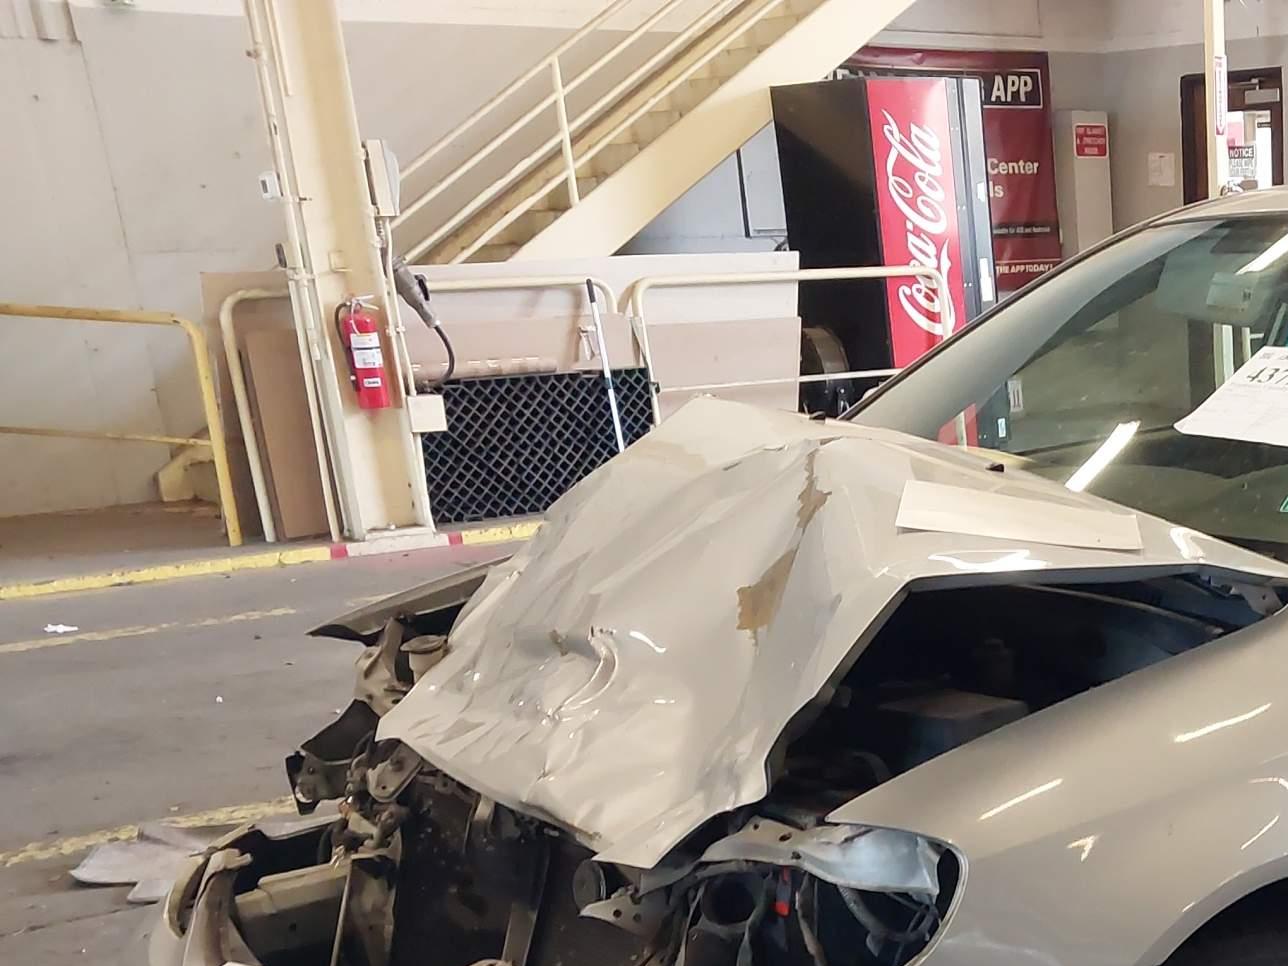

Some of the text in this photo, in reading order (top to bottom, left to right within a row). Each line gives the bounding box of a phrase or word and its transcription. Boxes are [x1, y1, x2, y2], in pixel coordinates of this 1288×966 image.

[990, 75, 1032, 102] APP
[1229, 148, 1253, 158] NOTICE
[987, 158, 1039, 175] Center
